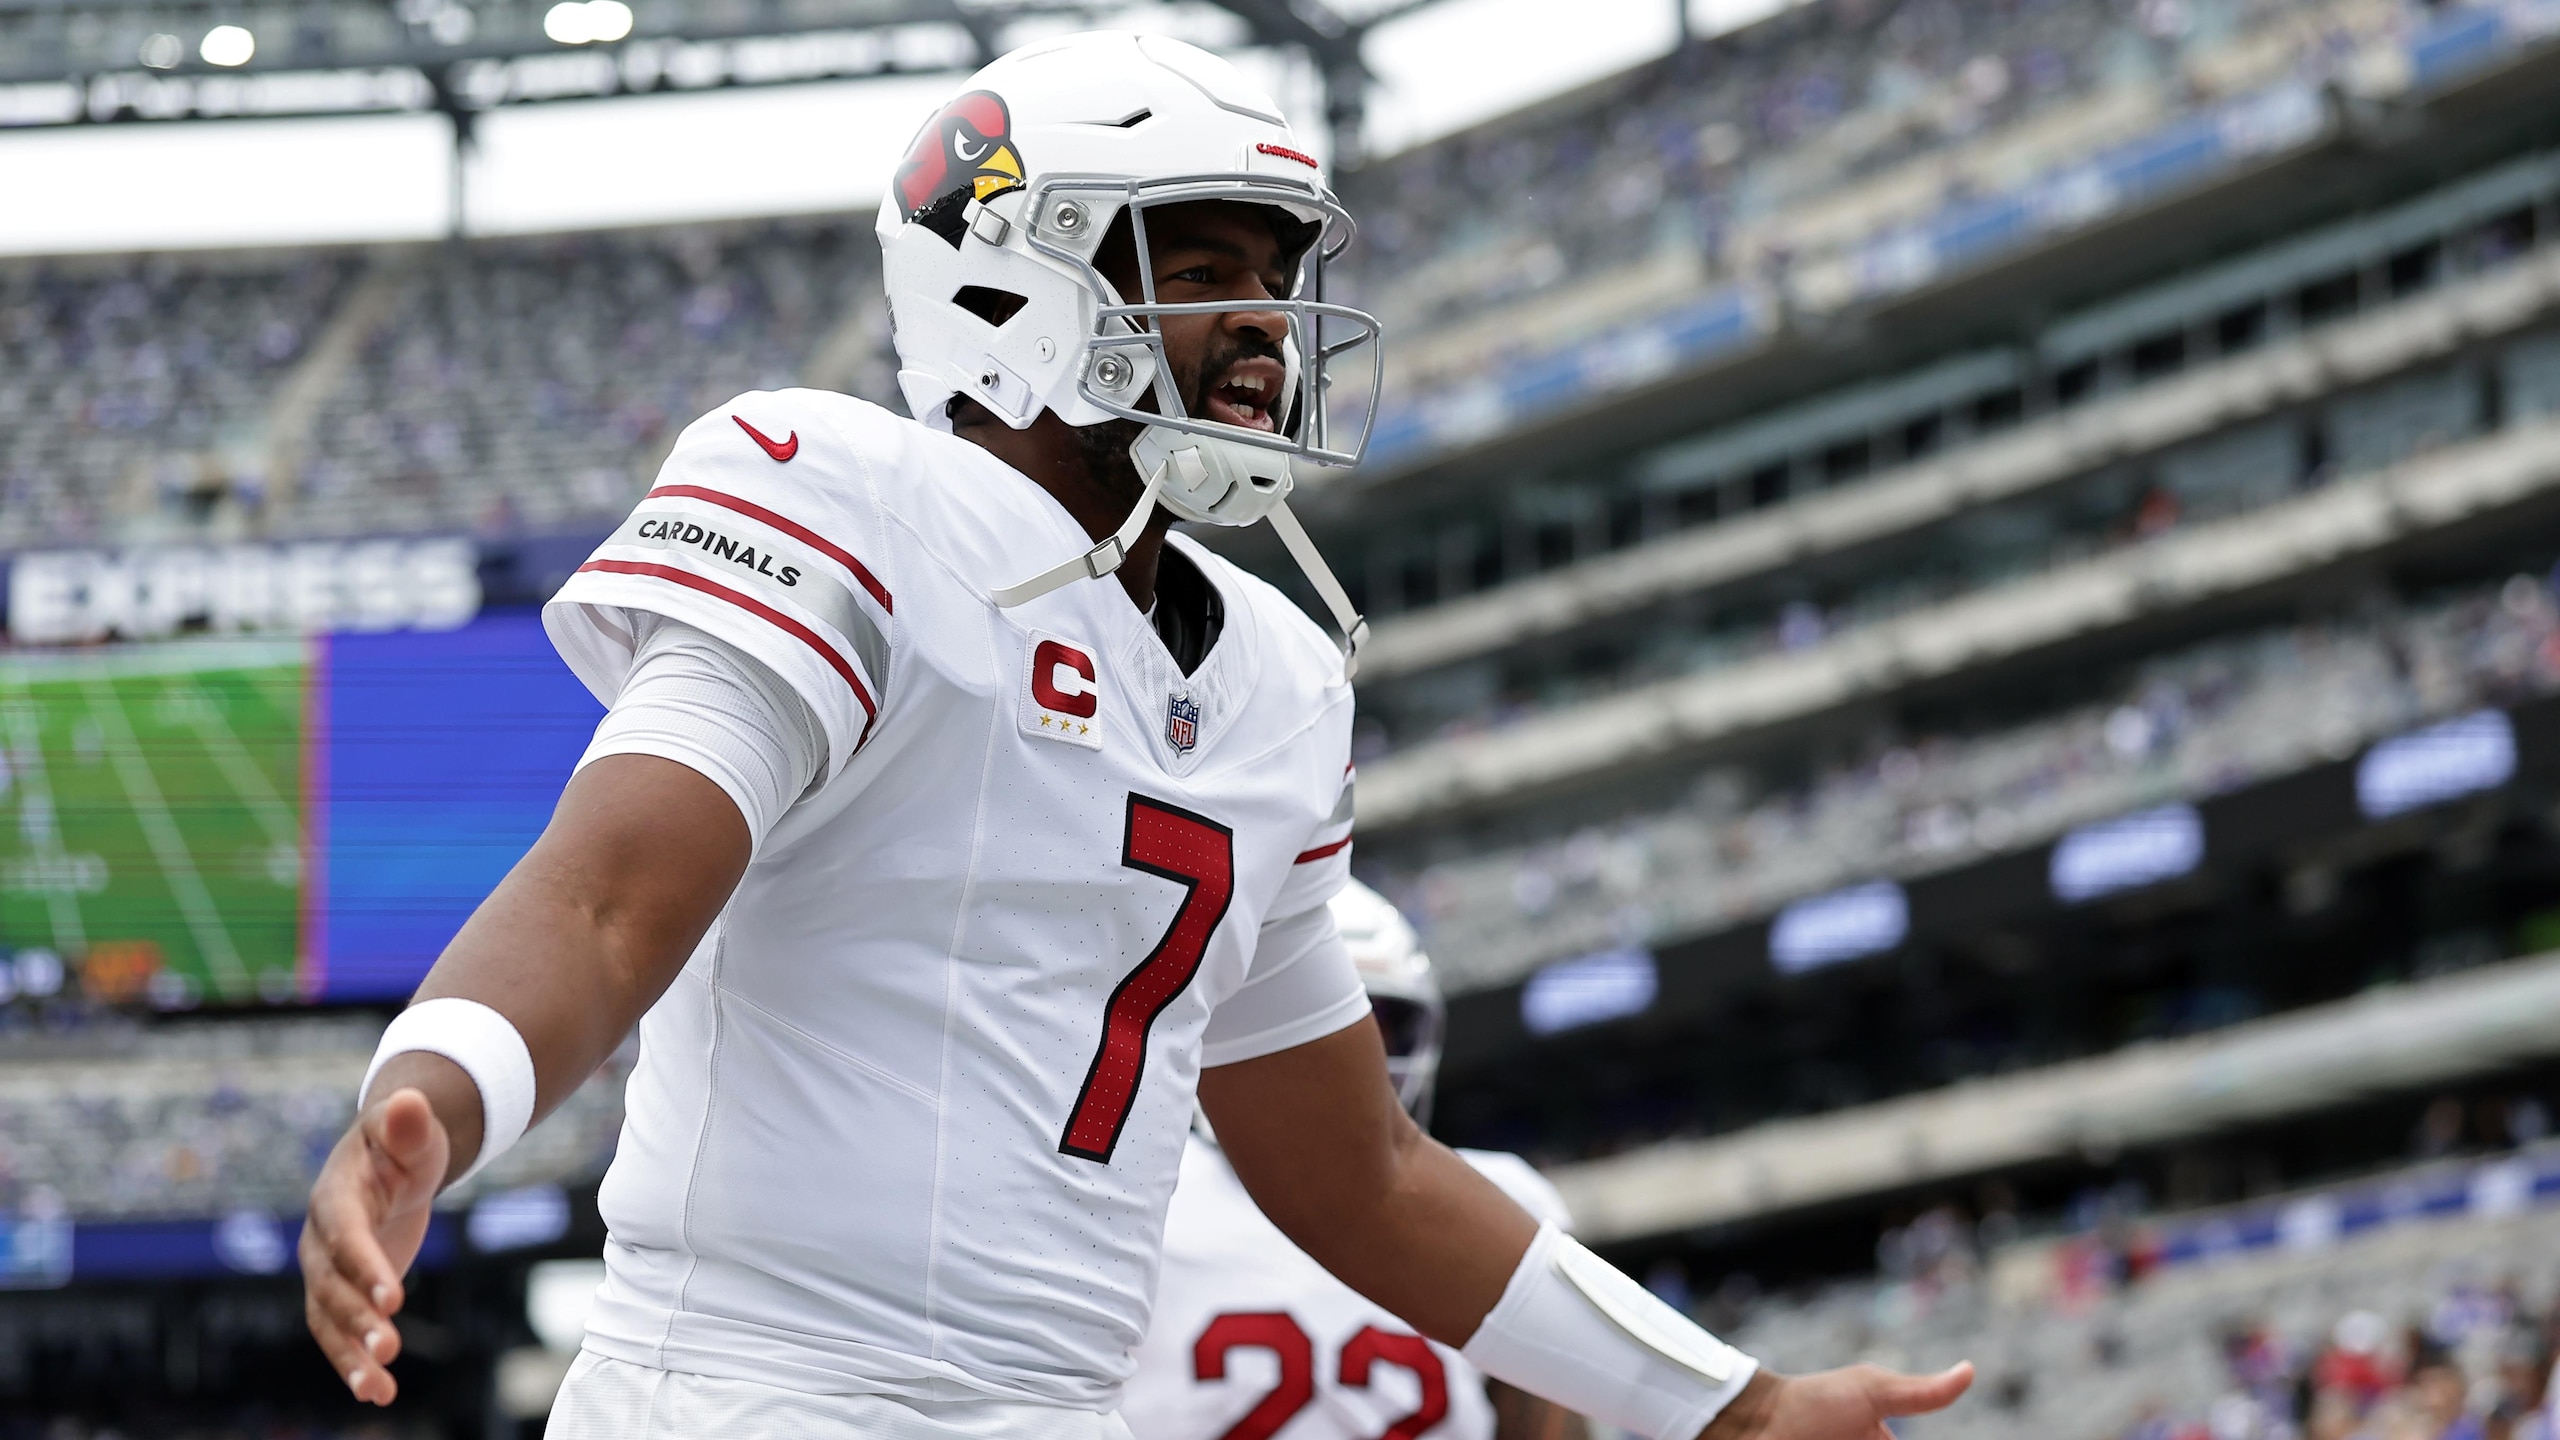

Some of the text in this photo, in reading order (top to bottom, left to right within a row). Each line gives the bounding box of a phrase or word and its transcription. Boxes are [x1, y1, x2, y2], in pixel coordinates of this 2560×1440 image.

[9, 542, 482, 641] EXPRESS
[638, 520, 801, 587] CARDINALS
[1032, 640, 1097, 719] C
[1171, 717, 1194, 746] NFL
[1058, 791, 1234, 1165] 7
[1194, 1312, 1448, 1440] 22
